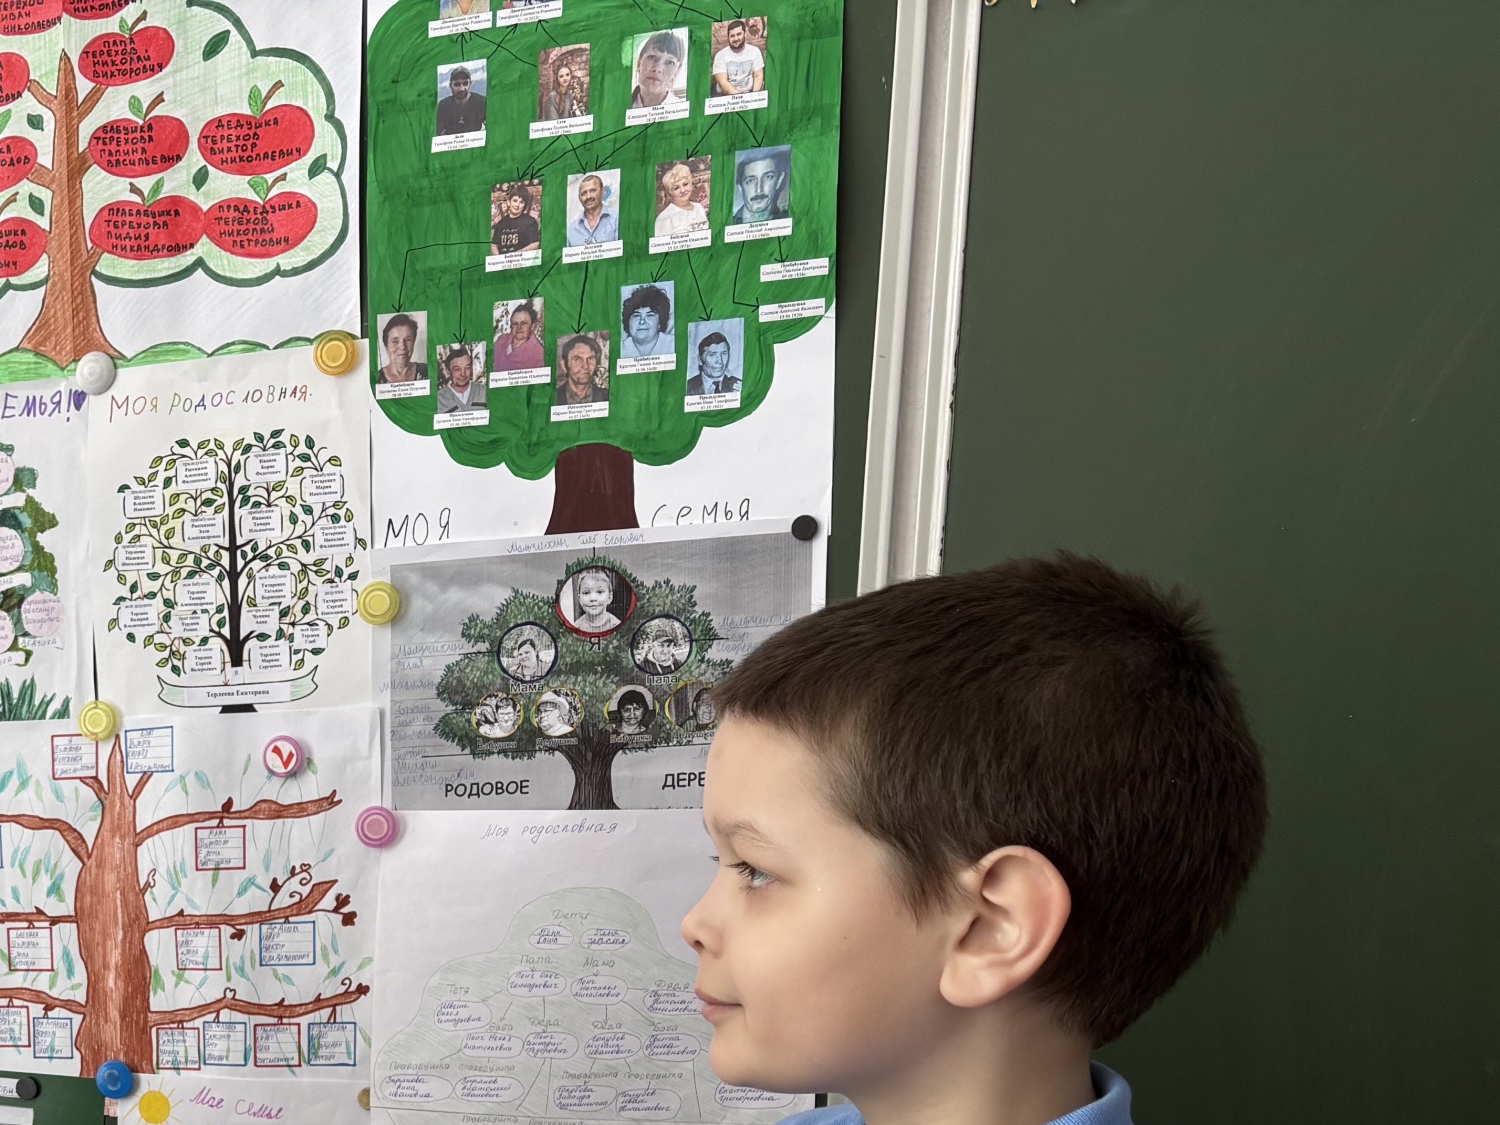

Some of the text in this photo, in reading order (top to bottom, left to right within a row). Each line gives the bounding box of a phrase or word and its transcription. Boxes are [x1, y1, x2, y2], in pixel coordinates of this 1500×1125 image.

[1, 12, 31, 21] ИВАН
[103, 37, 136, 48] ПАПА
[84, 46, 138, 59] ТЕРЕХОВ
[93, 53, 151, 68] НИКОЛАЙ
[93, 62, 163, 79] ВИКТОРОВИЧ
[102, 123, 154, 135] БАБУШКА
[215, 117, 279, 130] ДЕДУШКА
[94, 135, 154, 145] ТЕРЕХОВА
[202, 133, 261, 145] ТЕРЕХОВ
[100, 147, 147, 158] ГАЛИНА
[210, 143, 257, 155] ВИКТОР
[107, 154, 183, 168] ВАСИЛЬЕВНА
[220, 147, 302, 165] НИКОЛАЕВИЧ
[219, 200, 301, 215] ПРАДЕДУШКА
[215, 216, 269, 227] ТЕРЕХОВ
[219, 223, 275, 238] НИКОЛАЙ
[232, 237, 290, 248] ПЕТРОВИЧ
[110, 393, 158, 422] МОЯ
[384, 507, 452, 548] МОЯ
[589, 637, 600, 651] Я
[646, 675, 678, 685] Папа
[510, 683, 544, 693] Мама
[610, 734, 652, 744] Бабушка
[445, 772, 706, 799] РОДОВОЕ ДЕРЕ
[481, 818, 618, 843] Моя родословная
[520, 955, 615, 968] Папа Мама
